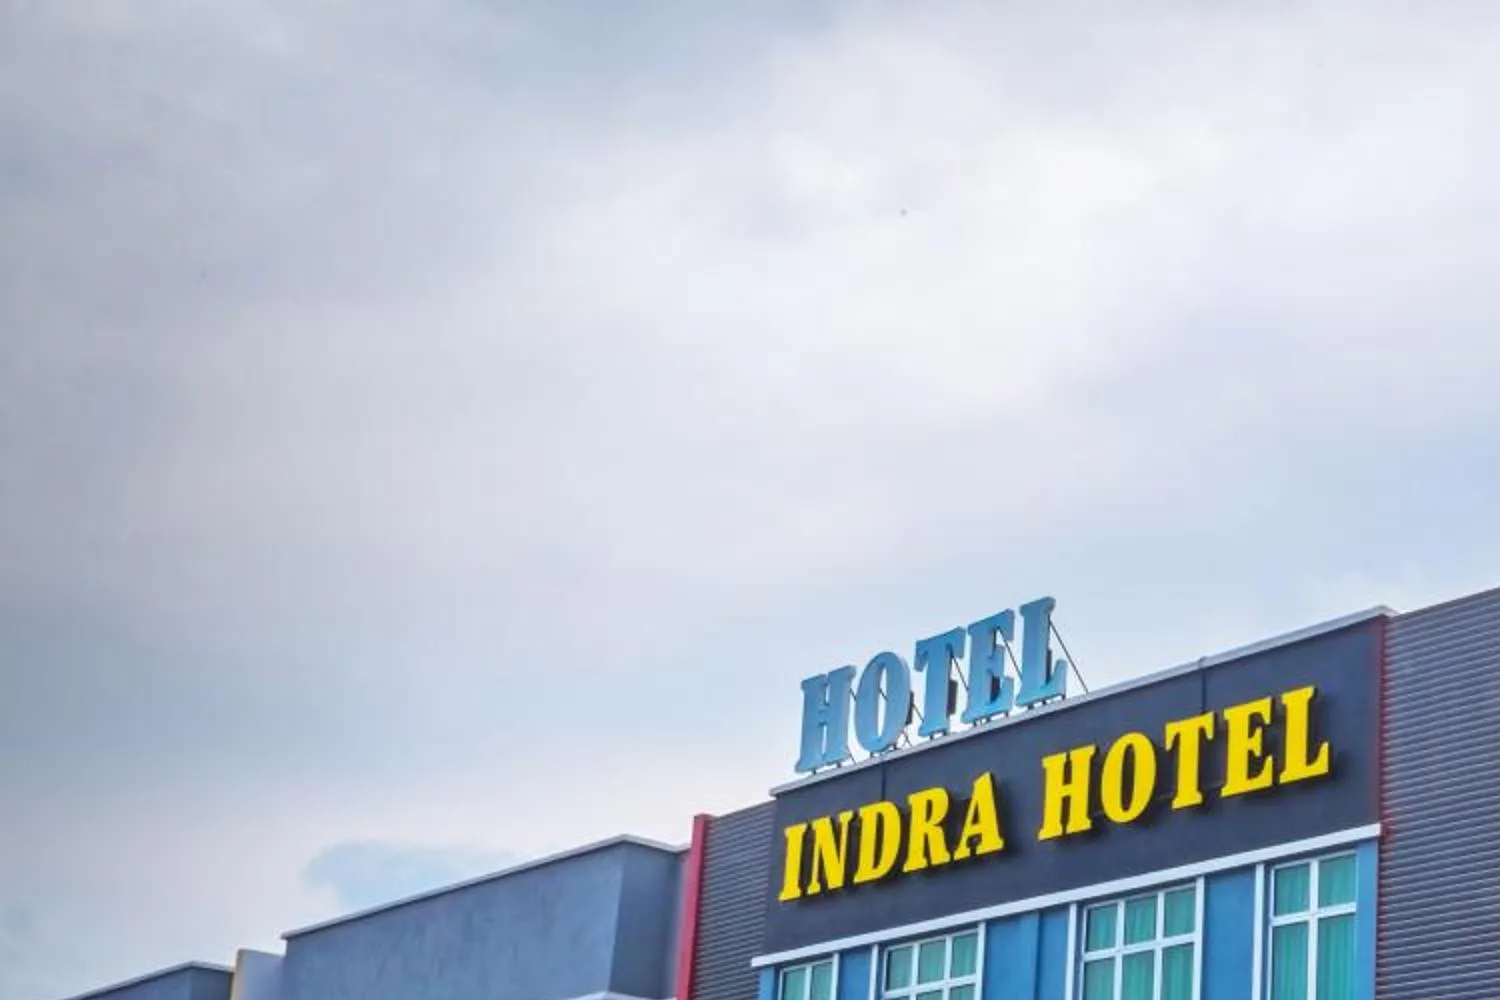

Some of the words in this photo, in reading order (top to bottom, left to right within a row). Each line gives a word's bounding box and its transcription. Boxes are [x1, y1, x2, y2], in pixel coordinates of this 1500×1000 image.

[796, 596, 1068, 773] HOTEL
[778, 771, 1004, 901] INDRA
[1038, 685, 1331, 841] HOTEL
